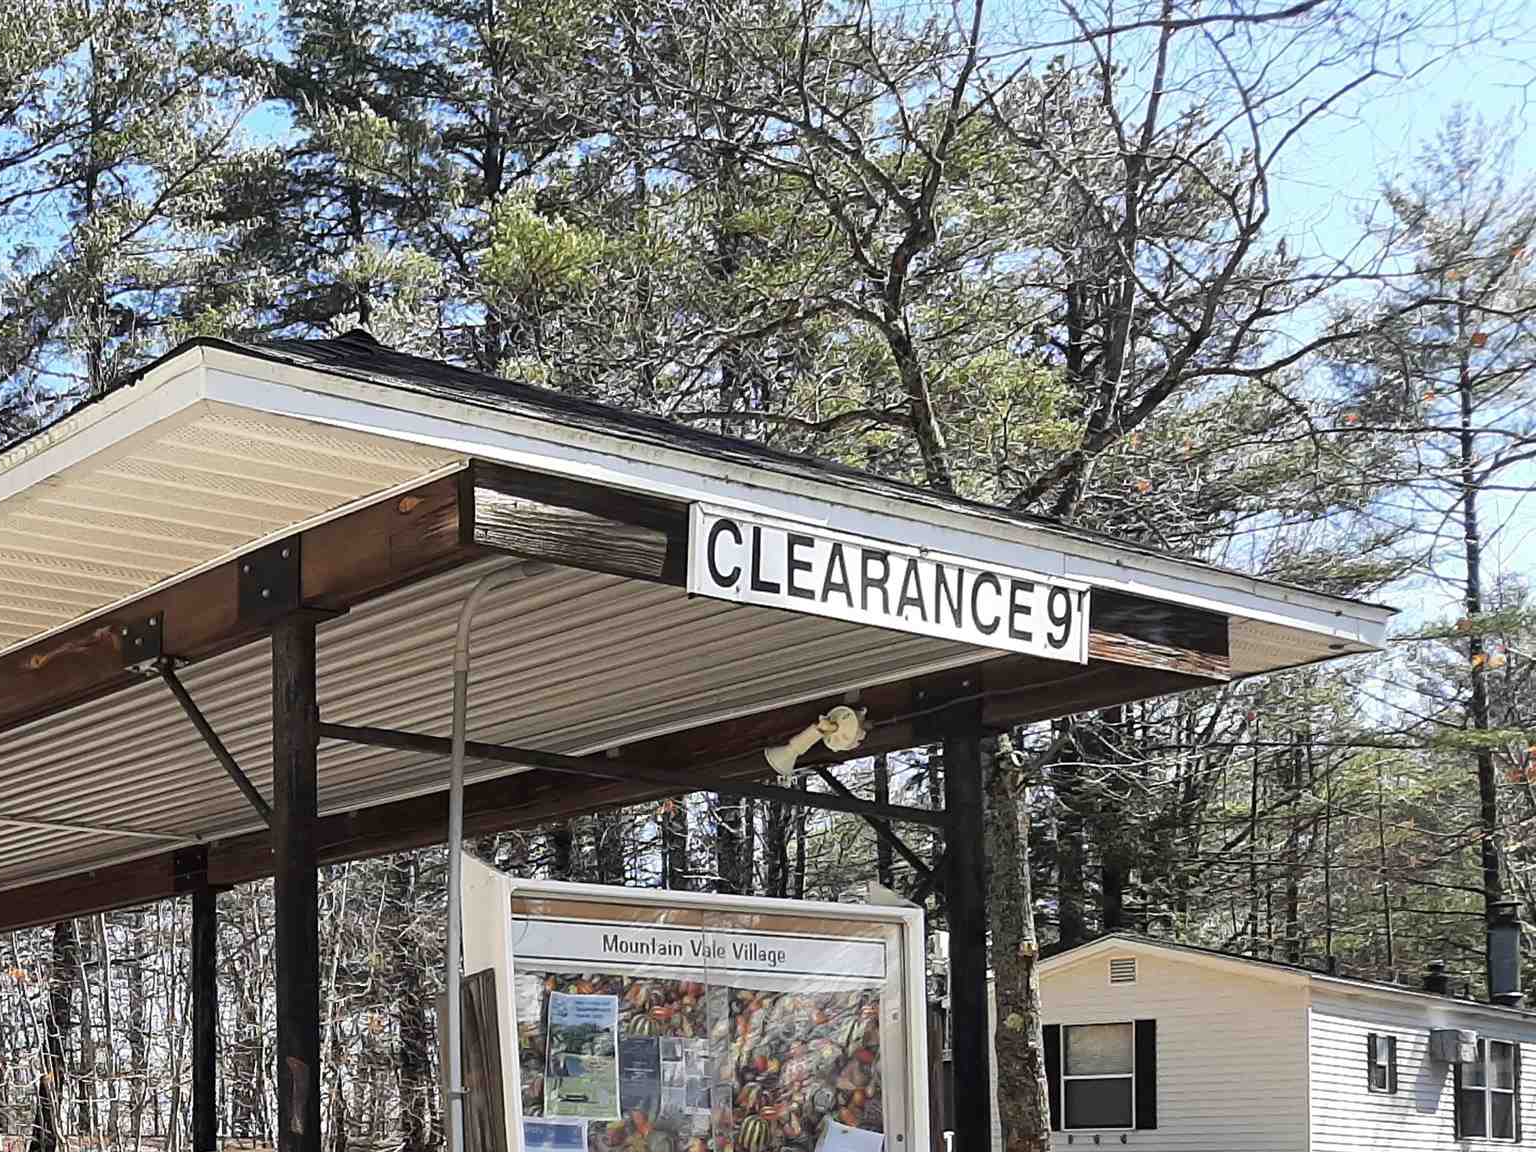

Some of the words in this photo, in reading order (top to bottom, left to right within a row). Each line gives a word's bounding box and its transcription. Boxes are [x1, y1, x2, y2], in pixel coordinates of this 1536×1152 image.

[706, 518, 1034, 642] CLEARANCE
[602, 933, 683, 957] Mountain
[690, 938, 726, 959] Vale
[732, 941, 786, 968] Village
